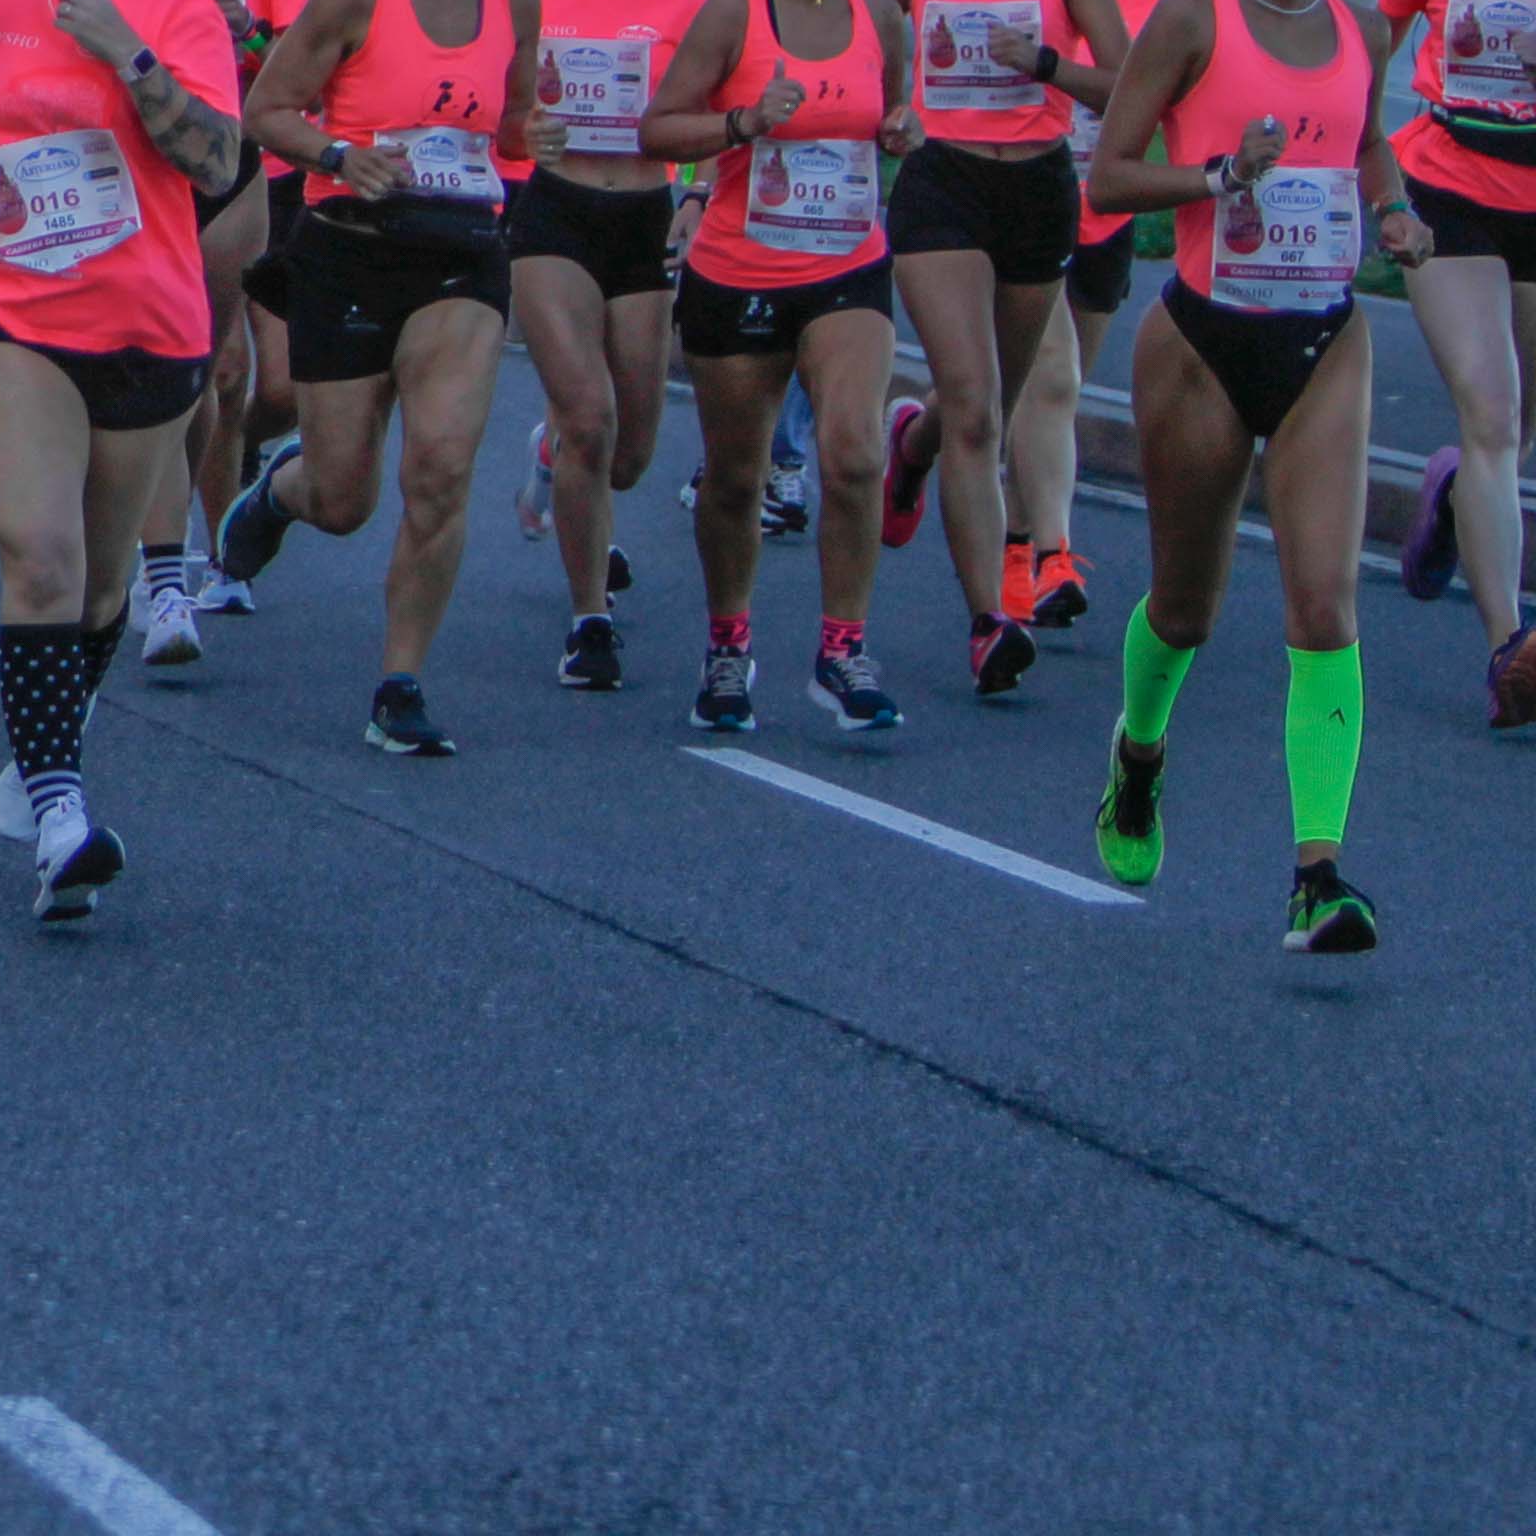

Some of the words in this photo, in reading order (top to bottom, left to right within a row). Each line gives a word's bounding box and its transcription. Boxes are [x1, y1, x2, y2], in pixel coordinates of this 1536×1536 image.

[1487, 35, 1512, 51] 01
[961, 44, 984, 60] 01
[566, 82, 606, 98] 016
[421, 171, 461, 187] 016
[794, 182, 836, 201] 016
[30, 187, 81, 214] 016
[44, 214, 76, 231] 1485
[1269, 224, 1318, 245] 016
[1281, 250, 1305, 263] 667
